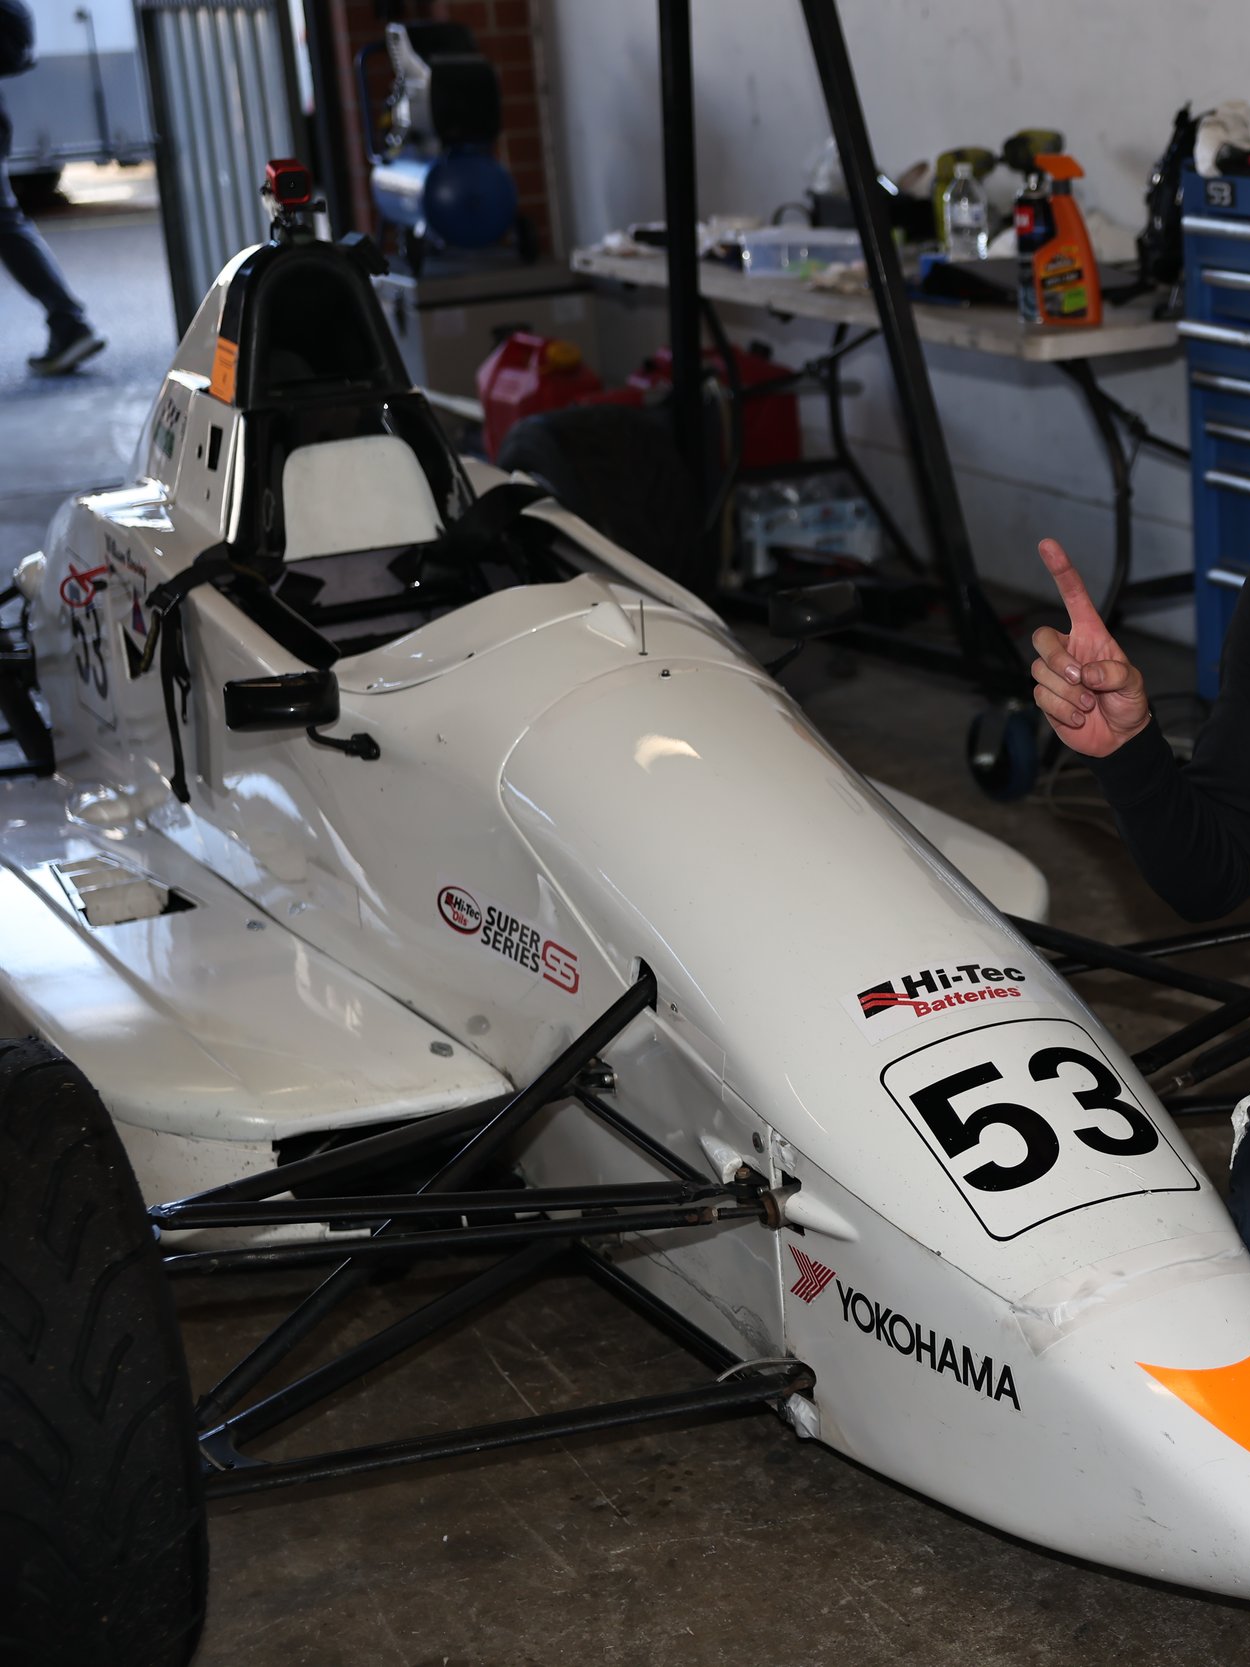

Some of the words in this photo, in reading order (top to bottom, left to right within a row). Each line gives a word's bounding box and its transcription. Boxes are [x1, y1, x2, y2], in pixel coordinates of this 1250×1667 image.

[452, 909, 468, 926] Oils
[453, 895, 481, 921] Hi-Tec
[485, 906, 541, 952] SUPER
[481, 926, 541, 973] SERIES
[901, 964, 1026, 999] Hi-Tec
[912, 986, 1022, 1017] Batteries
[909, 1047, 1159, 1192] 53
[836, 1278, 1021, 1411] YOKOHAMA
